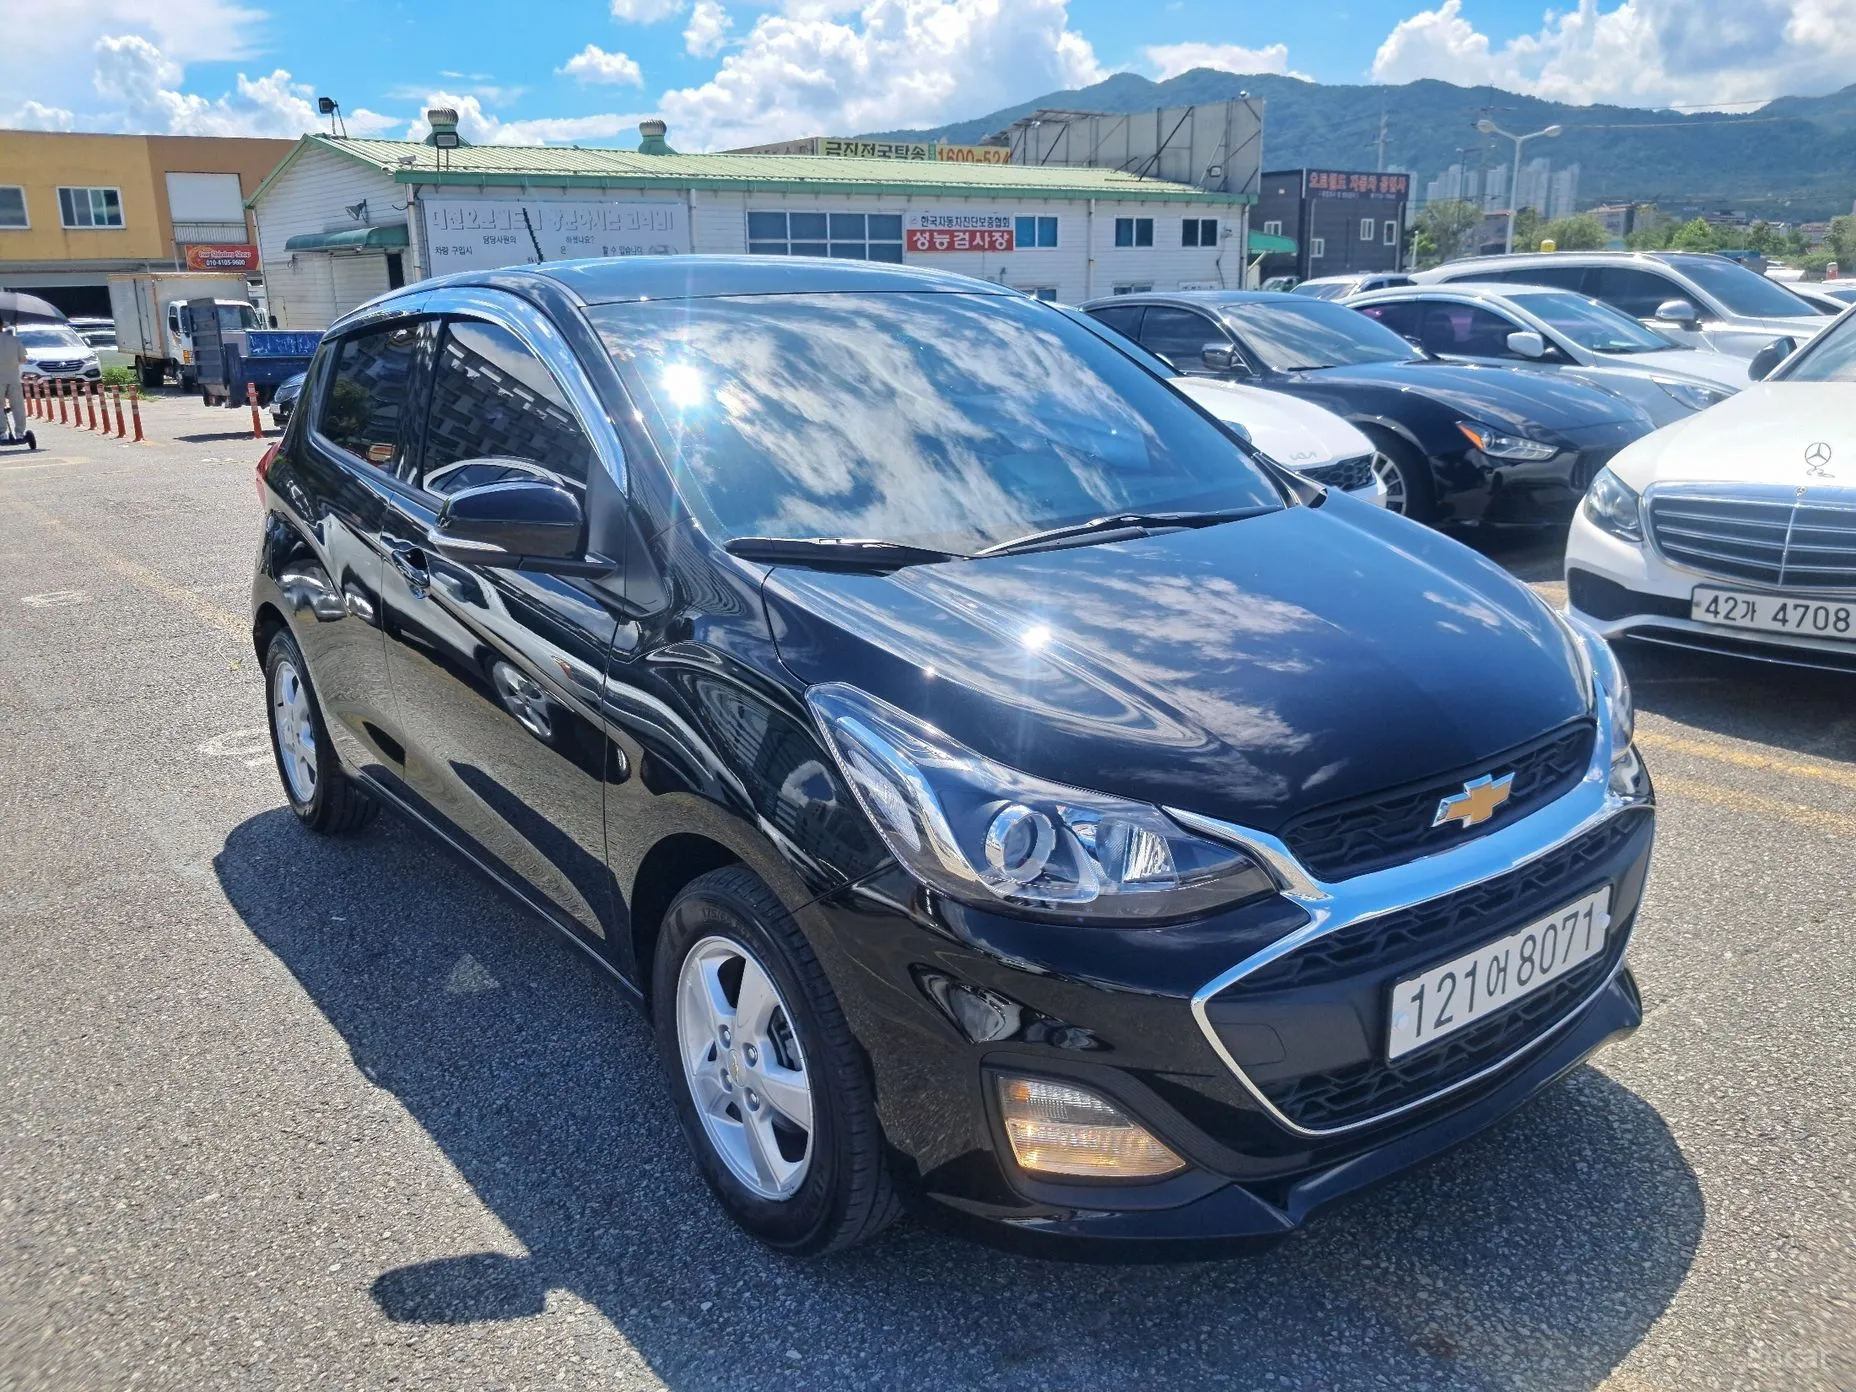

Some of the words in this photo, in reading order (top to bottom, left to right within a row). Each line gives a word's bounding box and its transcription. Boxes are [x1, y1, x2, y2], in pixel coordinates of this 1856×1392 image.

[912, 231, 1010, 250] 성능검사장
[1704, 594, 1757, 622] 42가
[1771, 602, 1851, 633] 4708
[1409, 901, 1595, 1038] 121어8071
